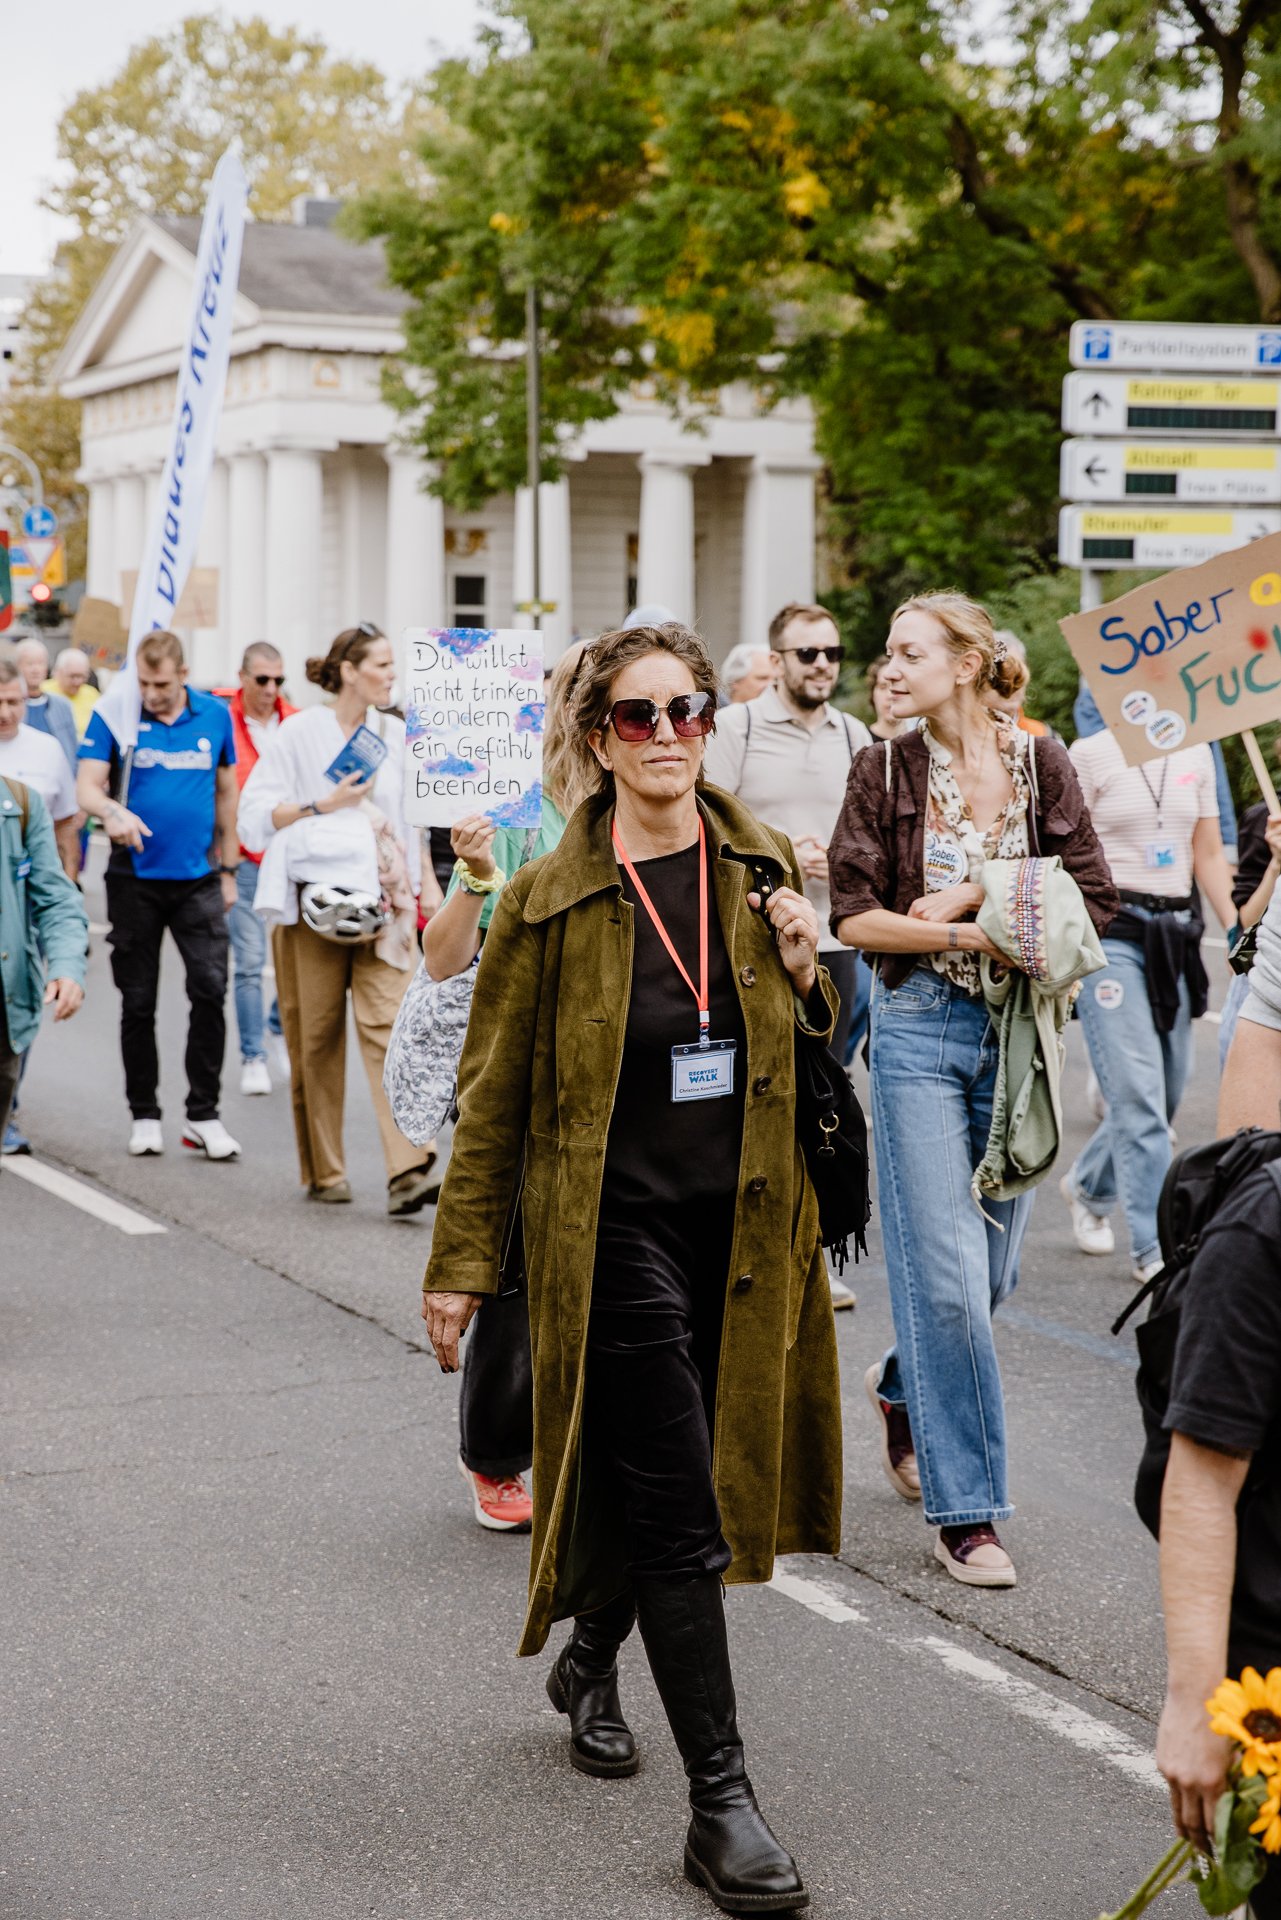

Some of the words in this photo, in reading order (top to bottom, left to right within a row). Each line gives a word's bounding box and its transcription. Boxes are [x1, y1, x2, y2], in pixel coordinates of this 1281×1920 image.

[1100, 588, 1236, 675] Sober
[413, 641, 453, 672] Du
[466, 643, 529, 671] willst
[413, 678, 465, 704] nicht
[472, 676, 539, 703] trinken
[418, 702, 511, 728] sondern
[412, 735, 448, 760] ein
[457, 732, 533, 767] Gefühl
[416, 769, 522, 799] beenden
[689, 1068, 719, 1077] RECOVERY
[689, 1073, 718, 1084] WALK
